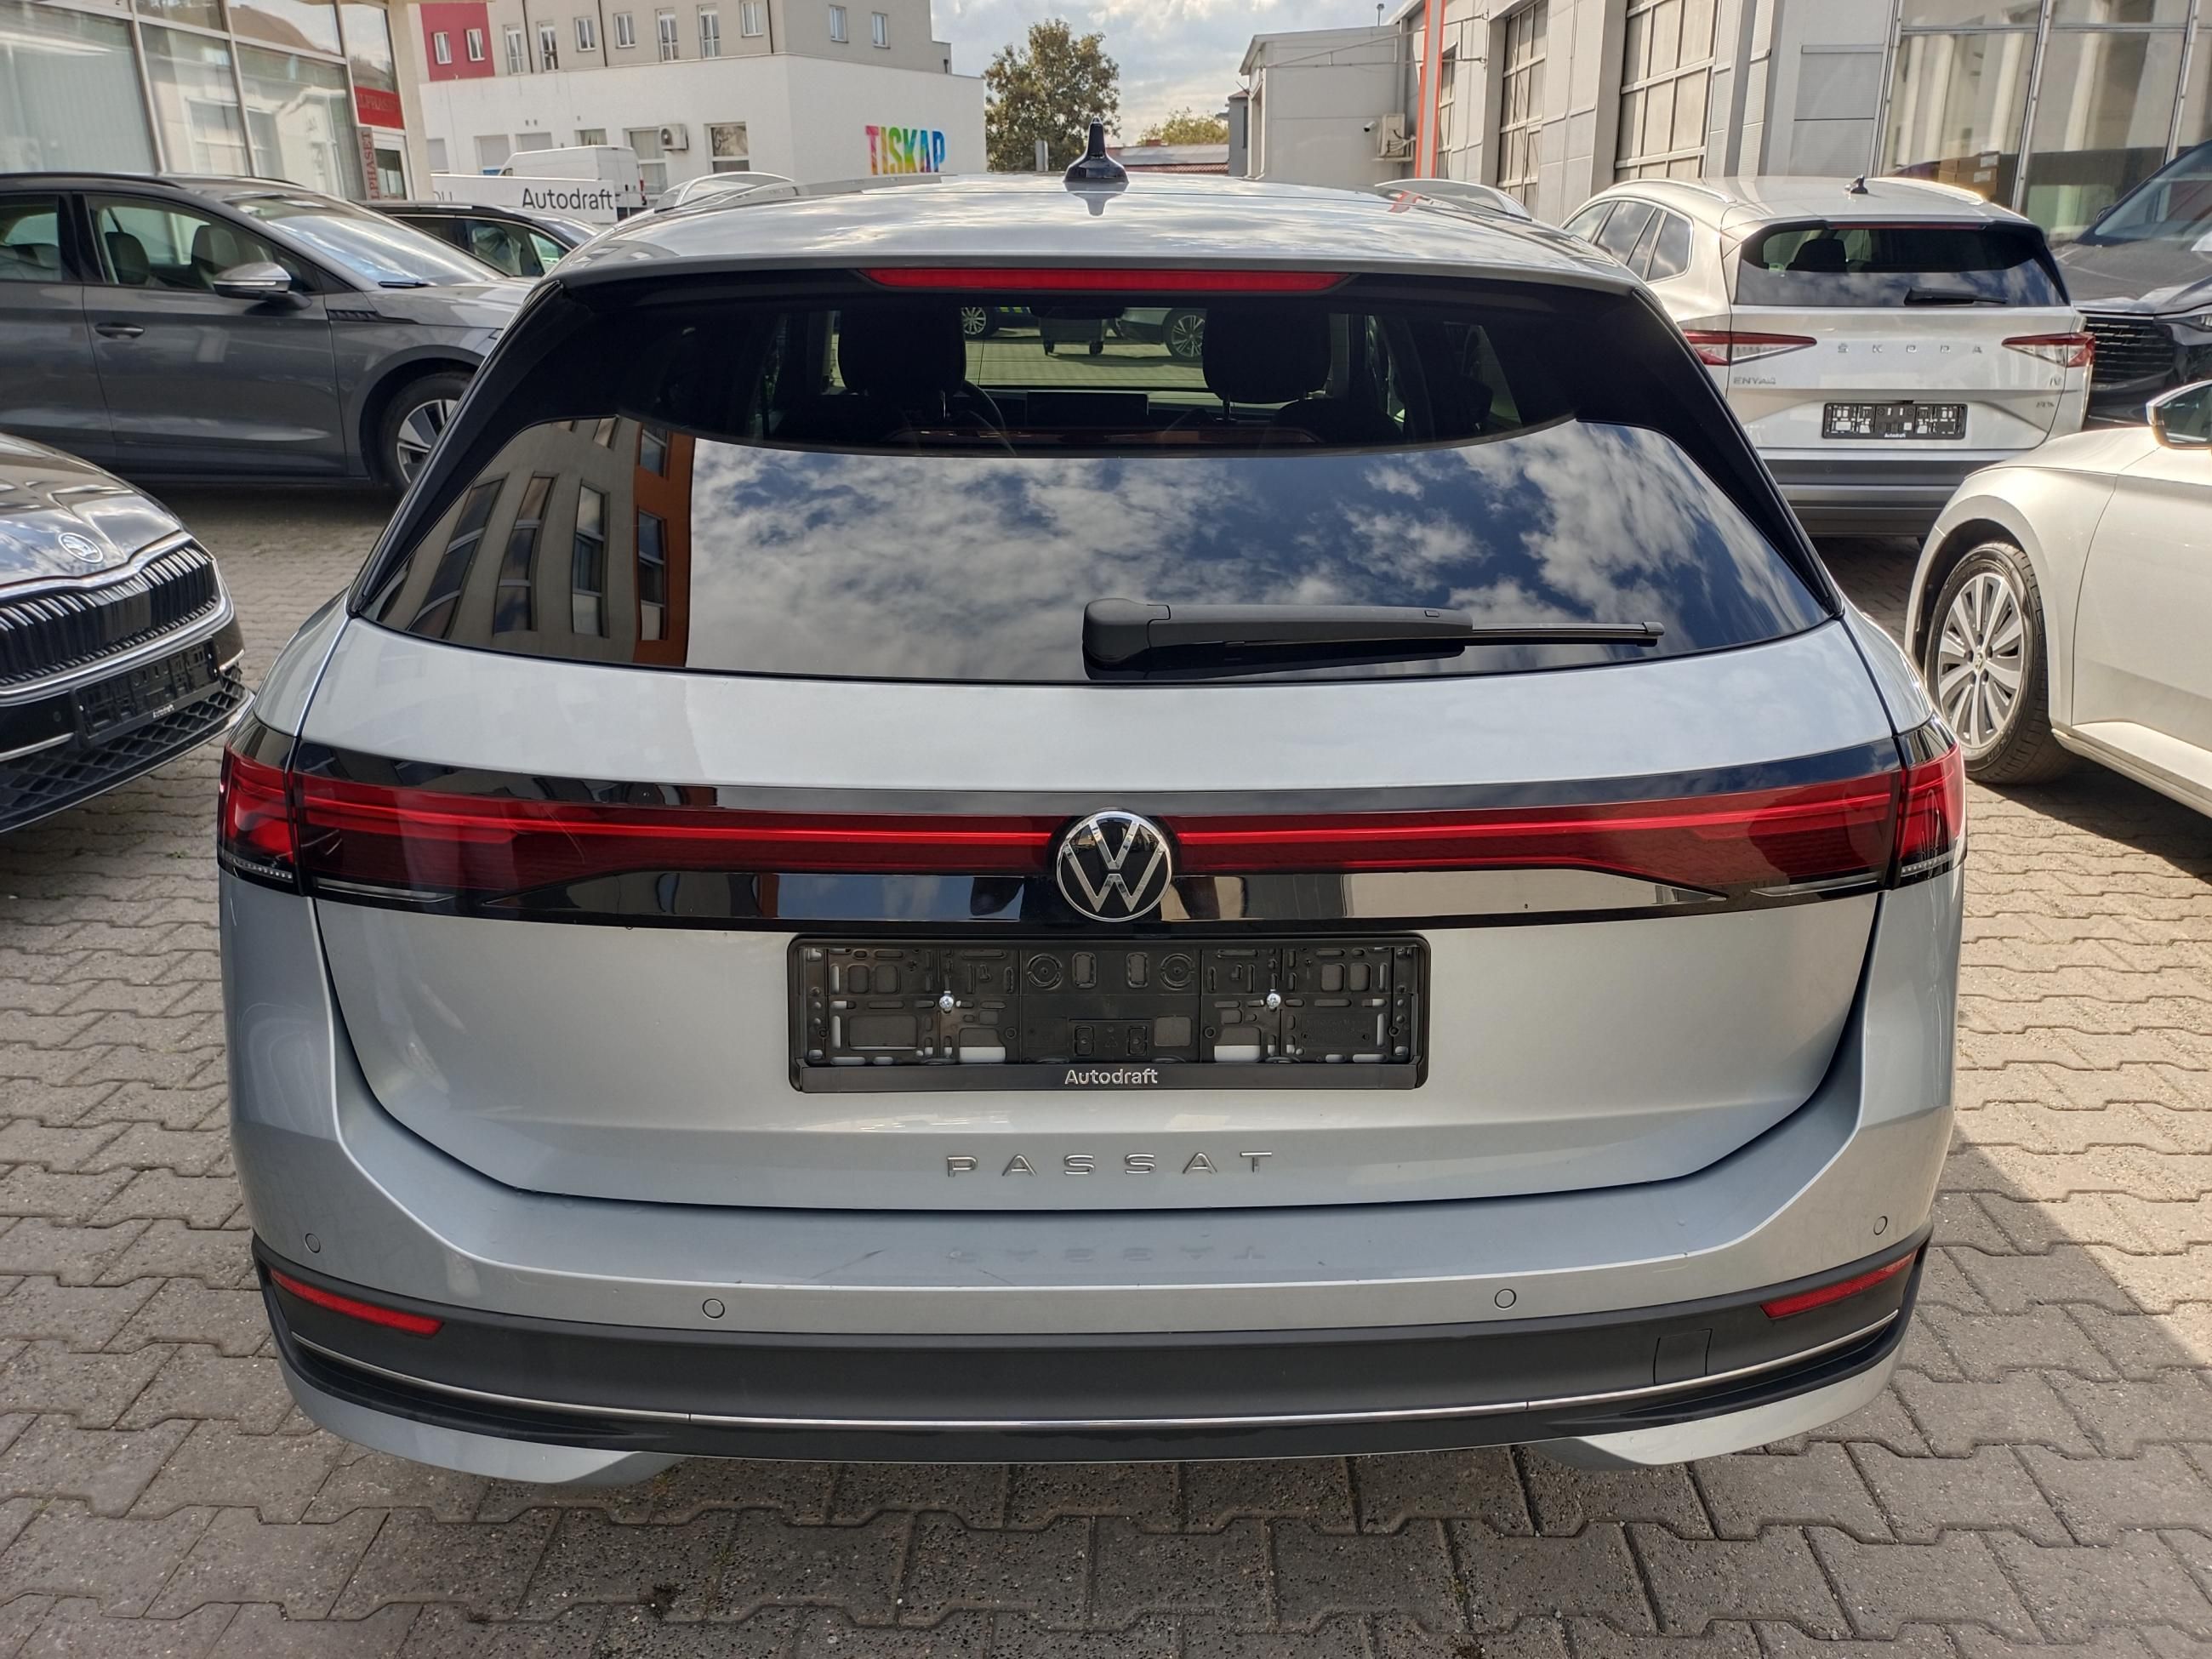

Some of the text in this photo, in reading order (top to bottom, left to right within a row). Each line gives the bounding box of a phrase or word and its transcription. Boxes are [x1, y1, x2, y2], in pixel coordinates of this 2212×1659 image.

[865, 125, 945, 175] TISKAP
[361, 130, 381, 200] LPHASET
[522, 187, 613, 210] Autodraft
[1064, 1068, 1159, 1085] Autodraft
[947, 1151, 1274, 1178] PASSAT
